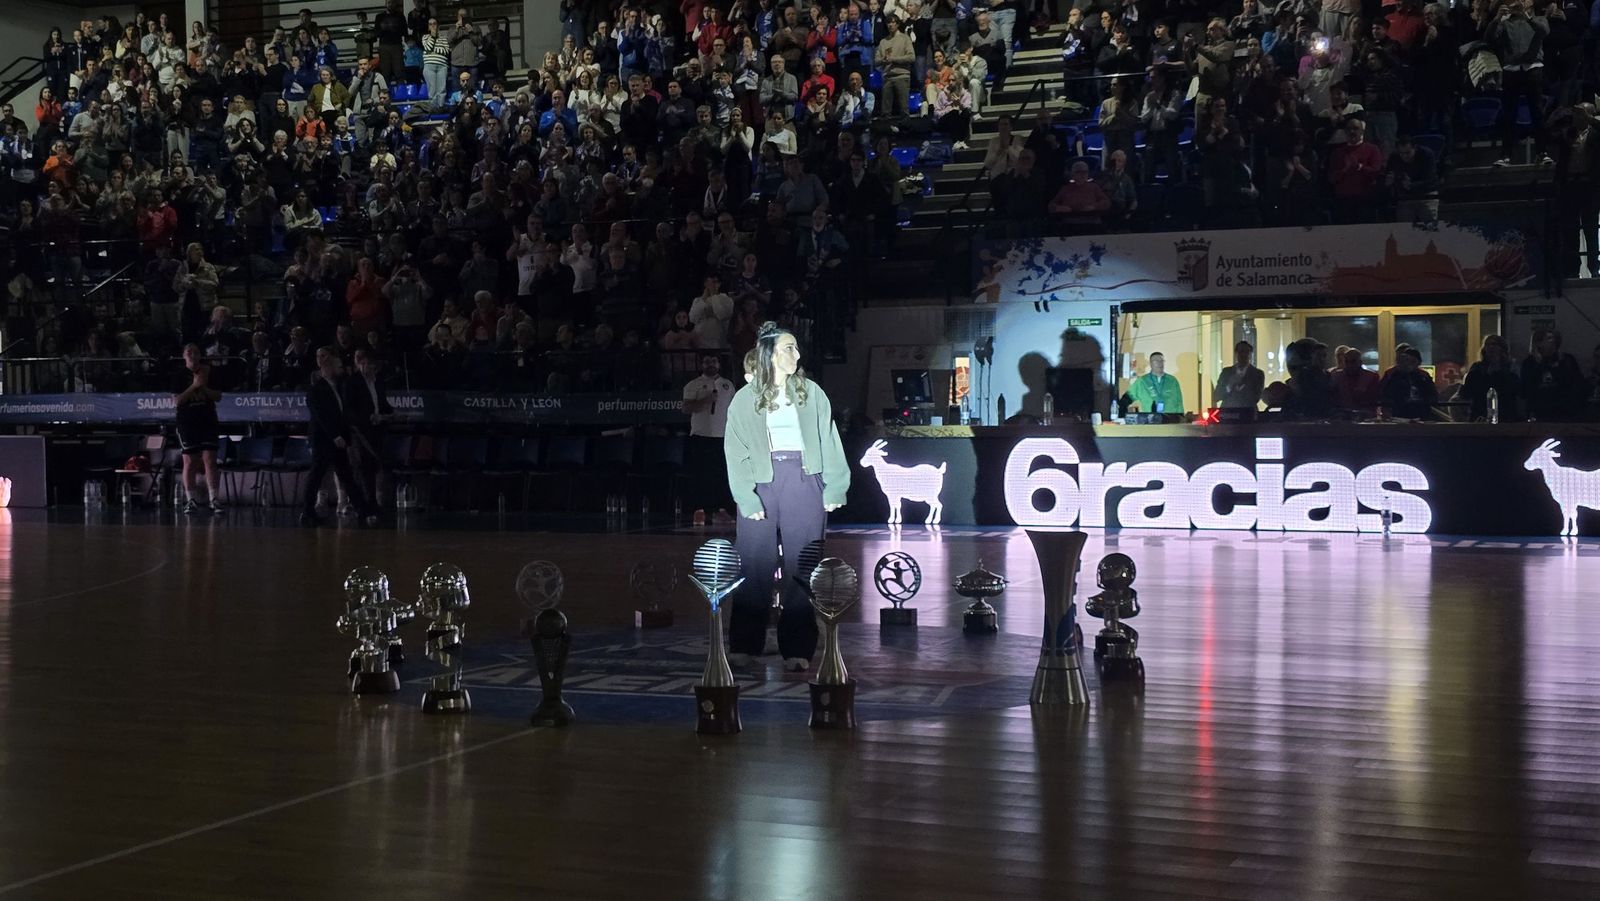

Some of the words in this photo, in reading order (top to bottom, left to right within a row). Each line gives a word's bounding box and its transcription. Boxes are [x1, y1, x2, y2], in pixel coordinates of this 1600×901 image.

[1216, 253, 1312, 272] Ayuntamiento
[1216, 273, 1232, 287] de
[1237, 272, 1312, 286] Salamanca
[235, 397, 282, 407] CASTILLA
[286, 397, 294, 408] Y
[463, 397, 516, 408] CASTILLA
[520, 398, 528, 410] Y
[532, 396, 562, 408] LEÓN
[1003, 437, 1433, 534] 6racias
